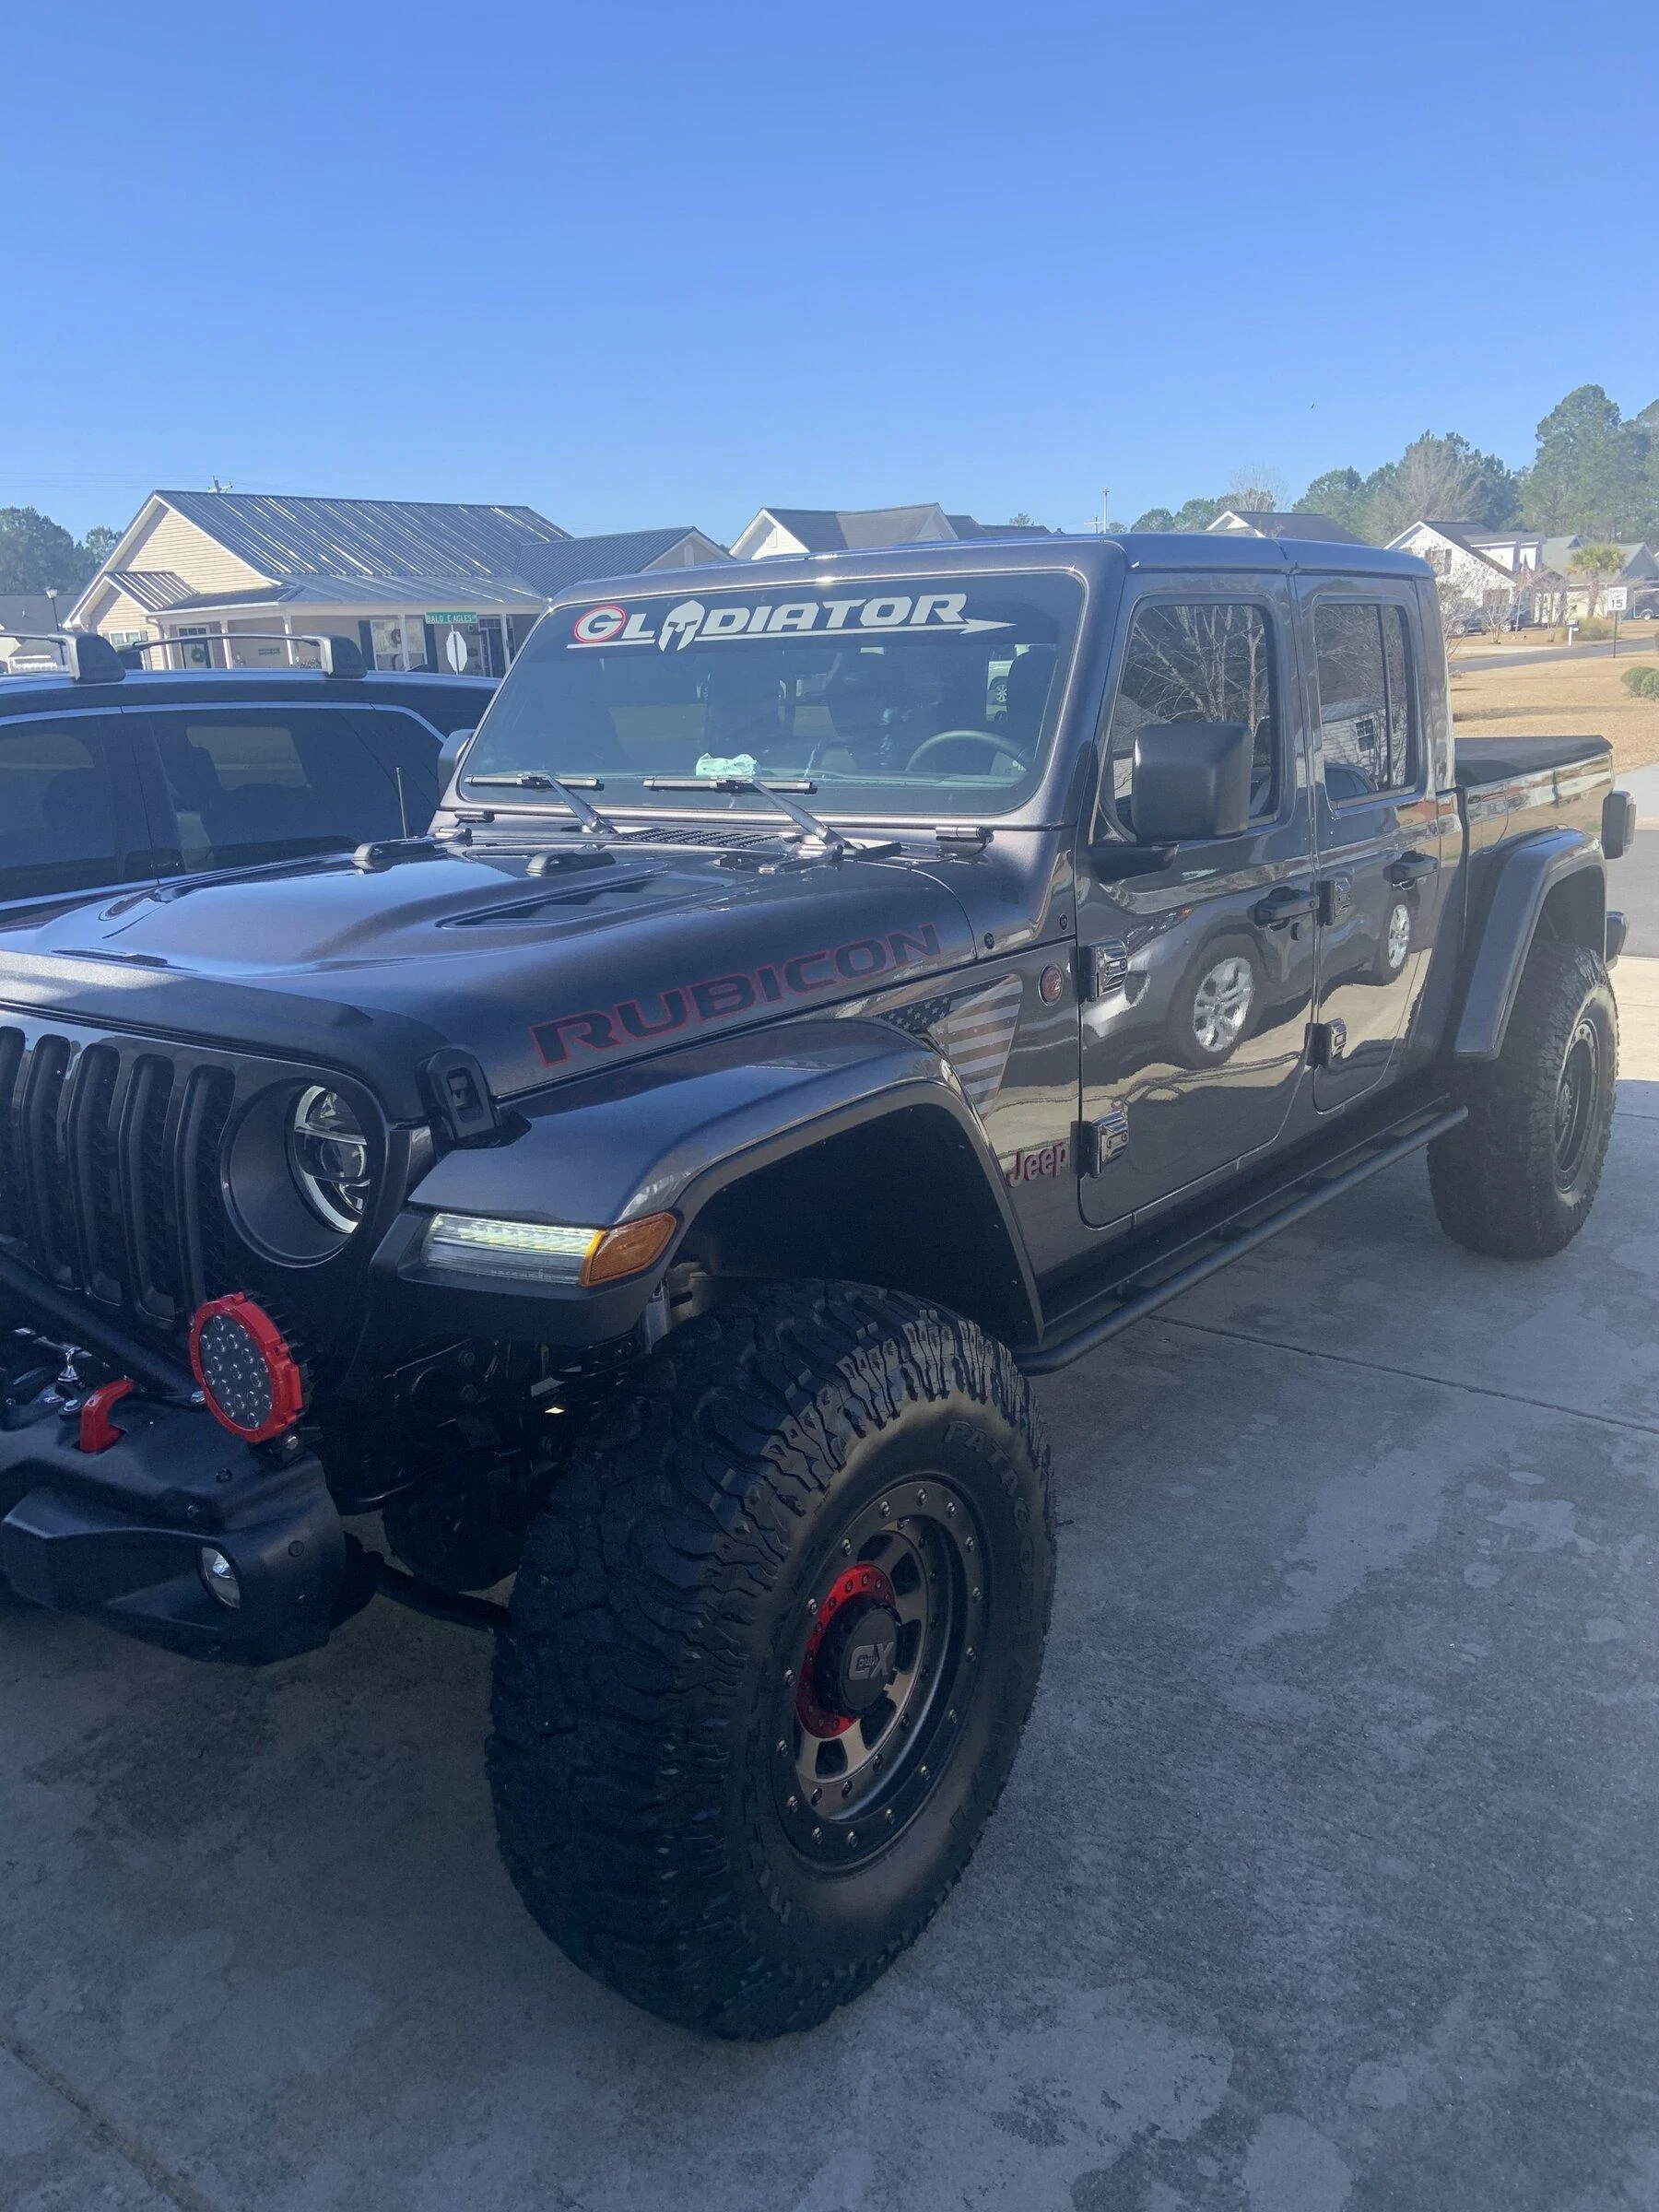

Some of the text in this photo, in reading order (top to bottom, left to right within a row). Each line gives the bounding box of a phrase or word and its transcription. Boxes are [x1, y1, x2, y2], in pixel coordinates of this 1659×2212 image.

[1611, 599, 1623, 608] 15
[426, 615, 443, 623] BALD
[447, 614, 472, 622] EAGLES
[528, 923, 942, 1066] RUBICON
[1006, 1142, 1069, 1188] Jeep
